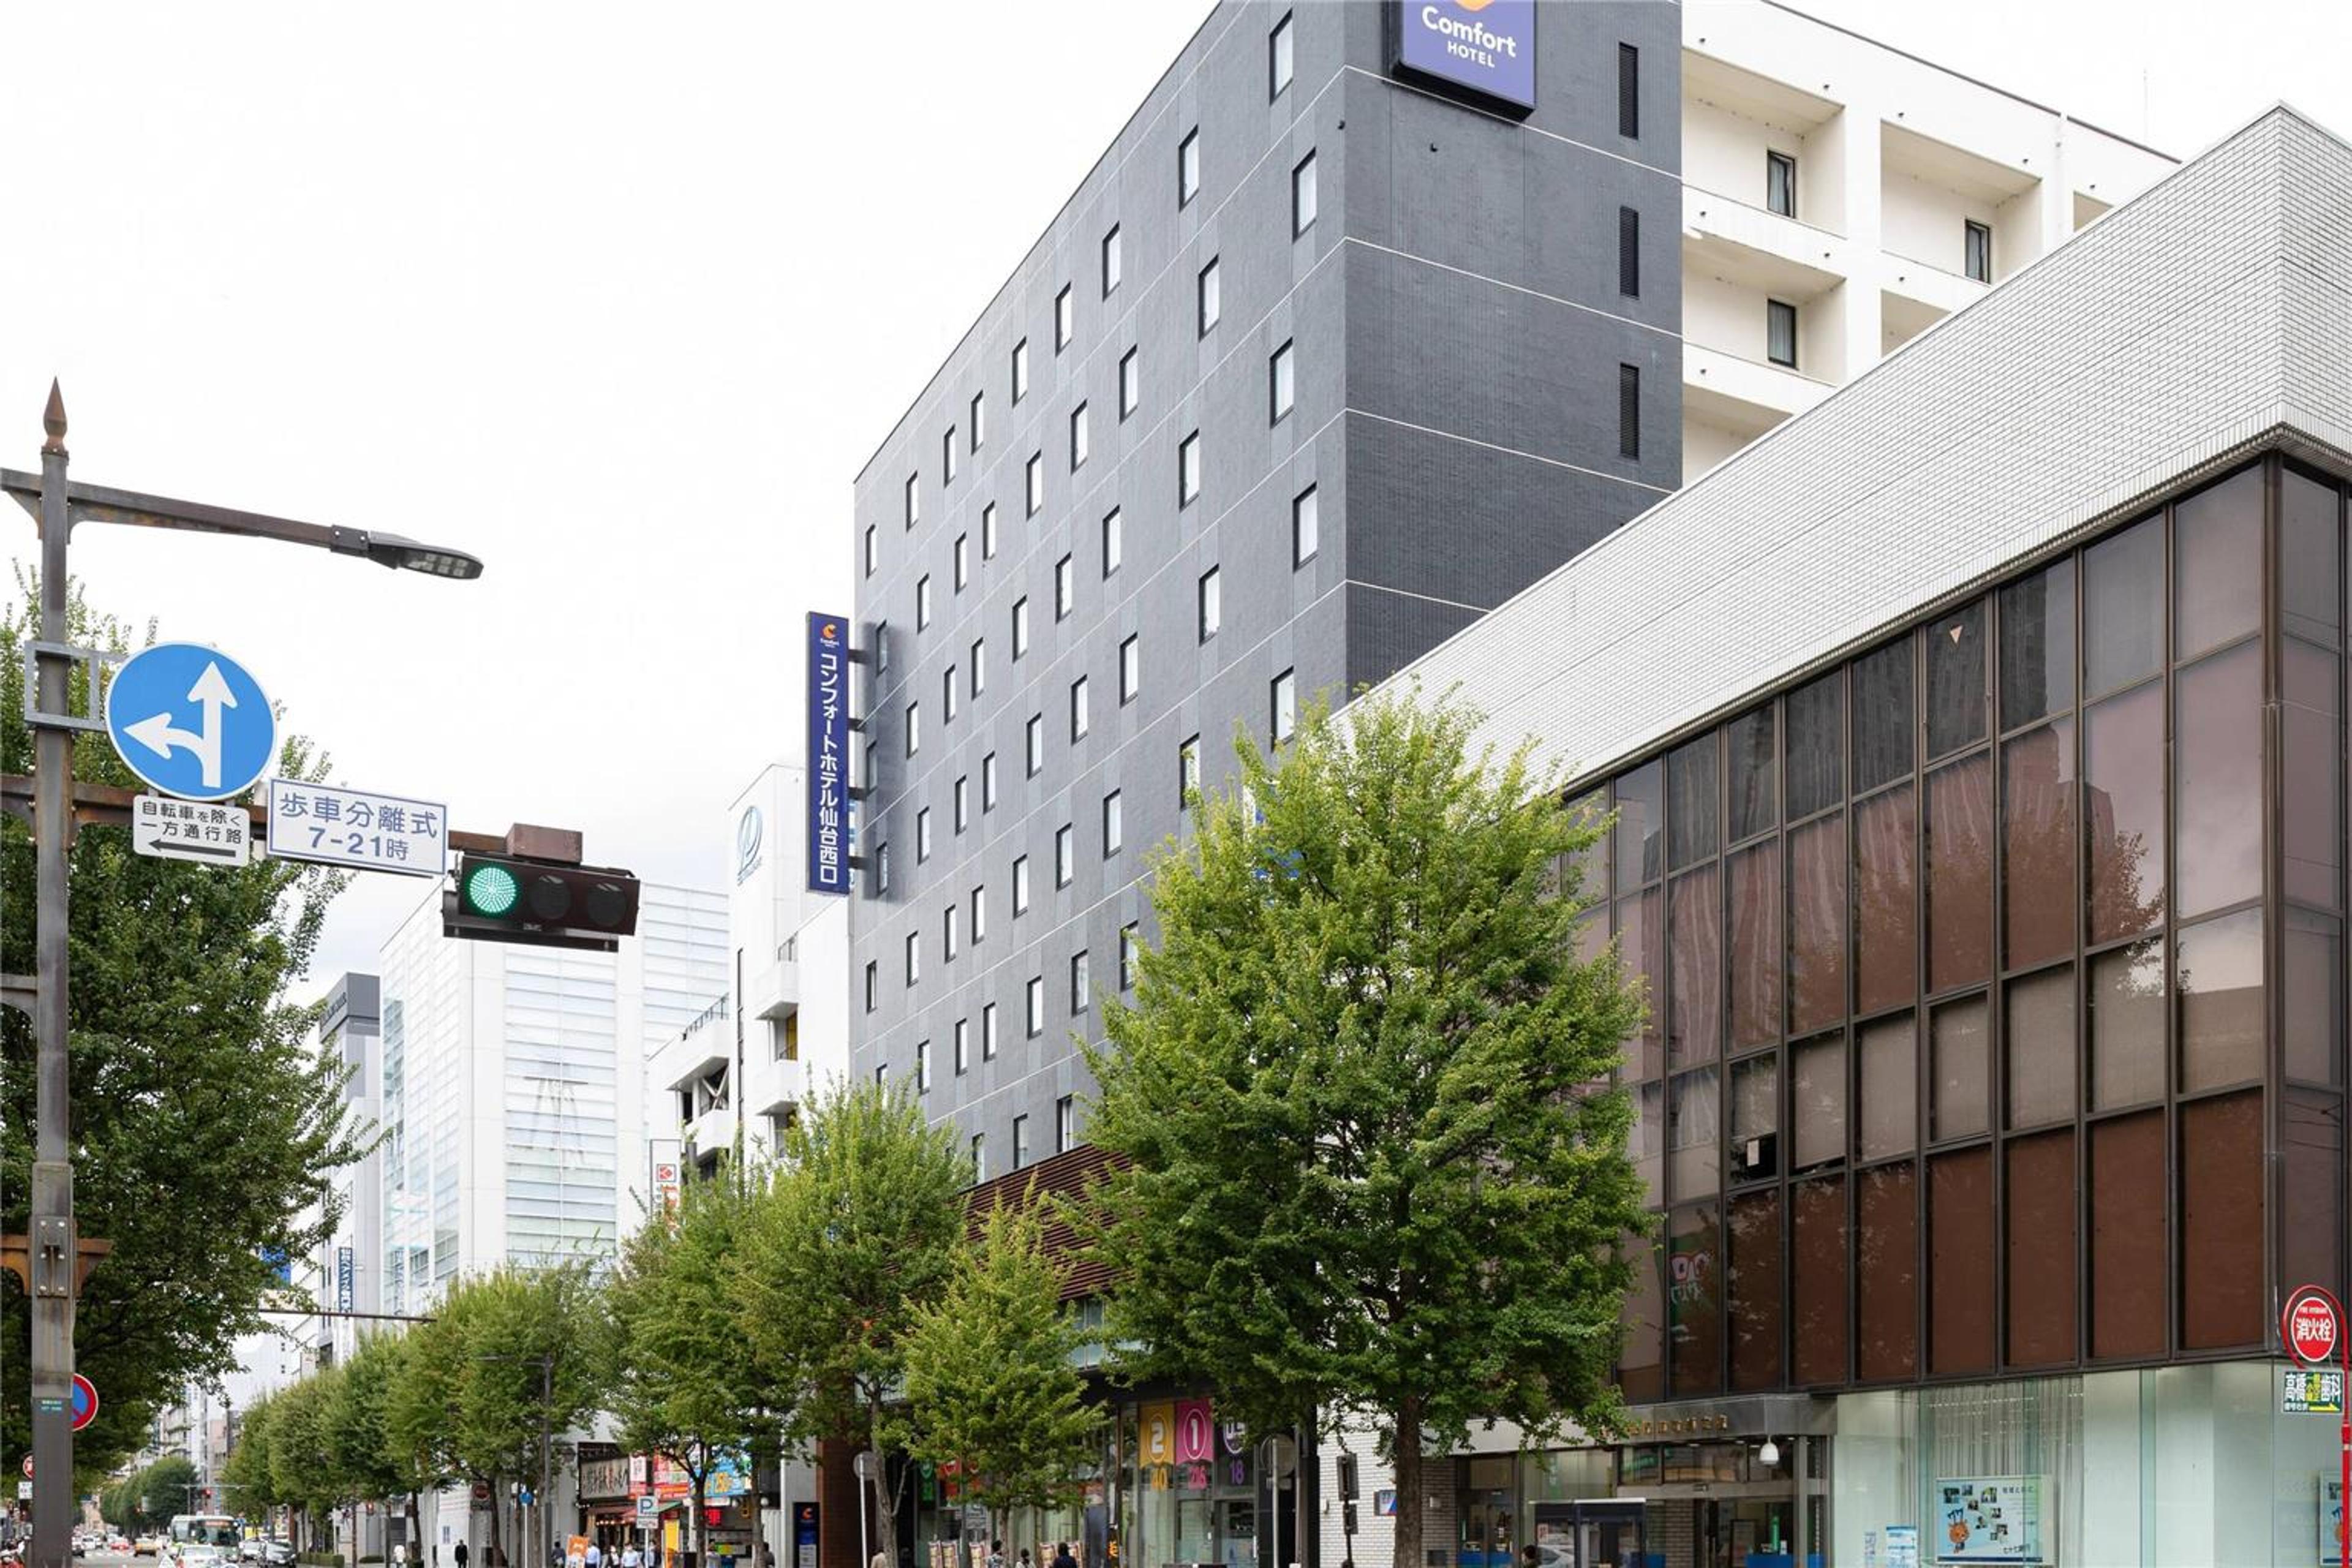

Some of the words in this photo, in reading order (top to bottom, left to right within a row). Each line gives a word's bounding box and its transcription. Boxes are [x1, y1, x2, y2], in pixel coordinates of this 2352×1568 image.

[1422, 6, 1516, 58] Comfort
[1447, 40, 1495, 68] HOTEL
[820, 653, 839, 884] コンフォートホテル仙台西口
[143, 801, 240, 827] 自転車を除く
[280, 792, 438, 839] 歩車分離式
[140, 821, 242, 844] 一方通行路
[309, 826, 409, 861] 7-21時
[2296, 1317, 2332, 1342] 消火栓
[1151, 1422, 1164, 1454] 2
[1191, 1418, 1198, 1451] 1
[1230, 1459, 1245, 1485] 18
[640, 1498, 653, 1514] P
